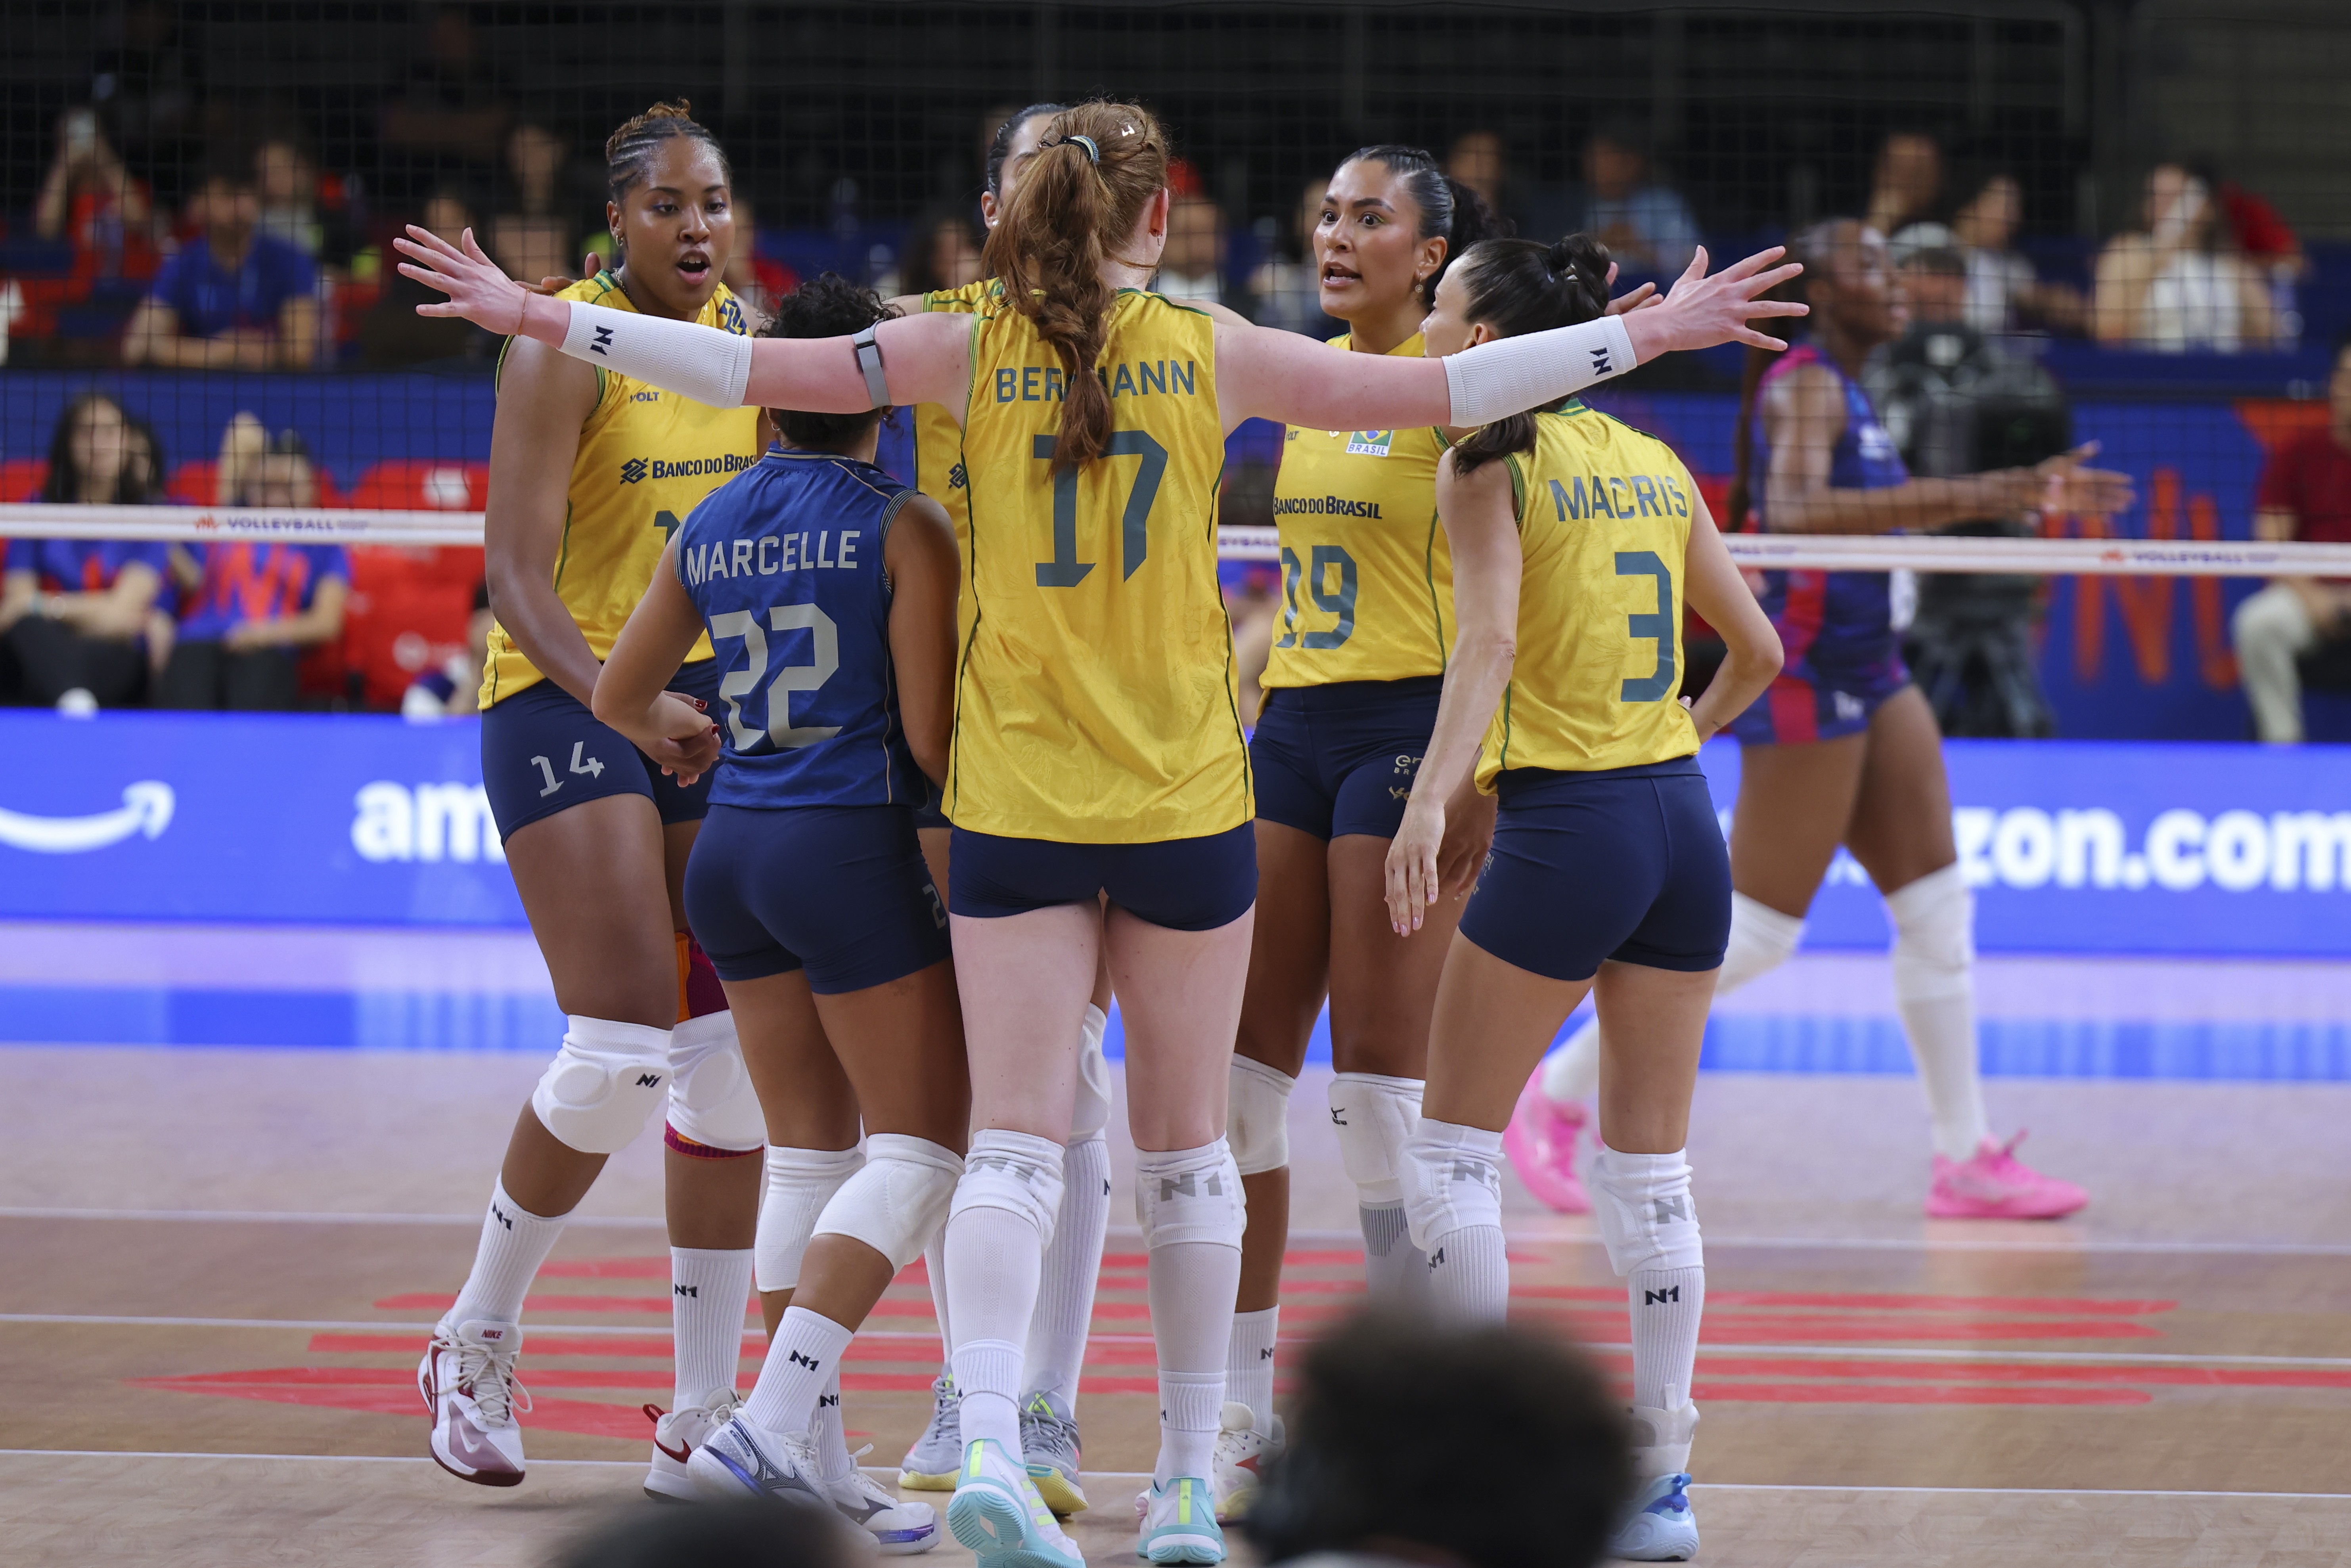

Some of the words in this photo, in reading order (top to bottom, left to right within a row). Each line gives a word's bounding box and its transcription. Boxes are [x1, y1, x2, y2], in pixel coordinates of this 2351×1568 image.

[996, 360, 1195, 403] BERANN
[652, 460, 702, 479] BANCO
[704, 458, 722, 474] DO
[724, 454, 756, 472] BRAS
[1348, 444, 1386, 455] BRASIL
[1034, 430, 1168, 587] 17
[1273, 497, 1307, 515] BANCO
[1309, 498, 1324, 514] DO
[1326, 496, 1382, 519] BRASIL
[1548, 475, 1688, 522] MACRIS
[228, 517, 334, 530] VOLLEYBALL
[686, 530, 860, 586] MARCELLE
[1275, 546, 1357, 649] 19
[1614, 551, 1674, 702] 3
[709, 603, 843, 750] 22
[530, 741, 605, 798] 14
[1645, 1285, 1679, 1305] N1
[481, 1329, 503, 1338] NIKE
